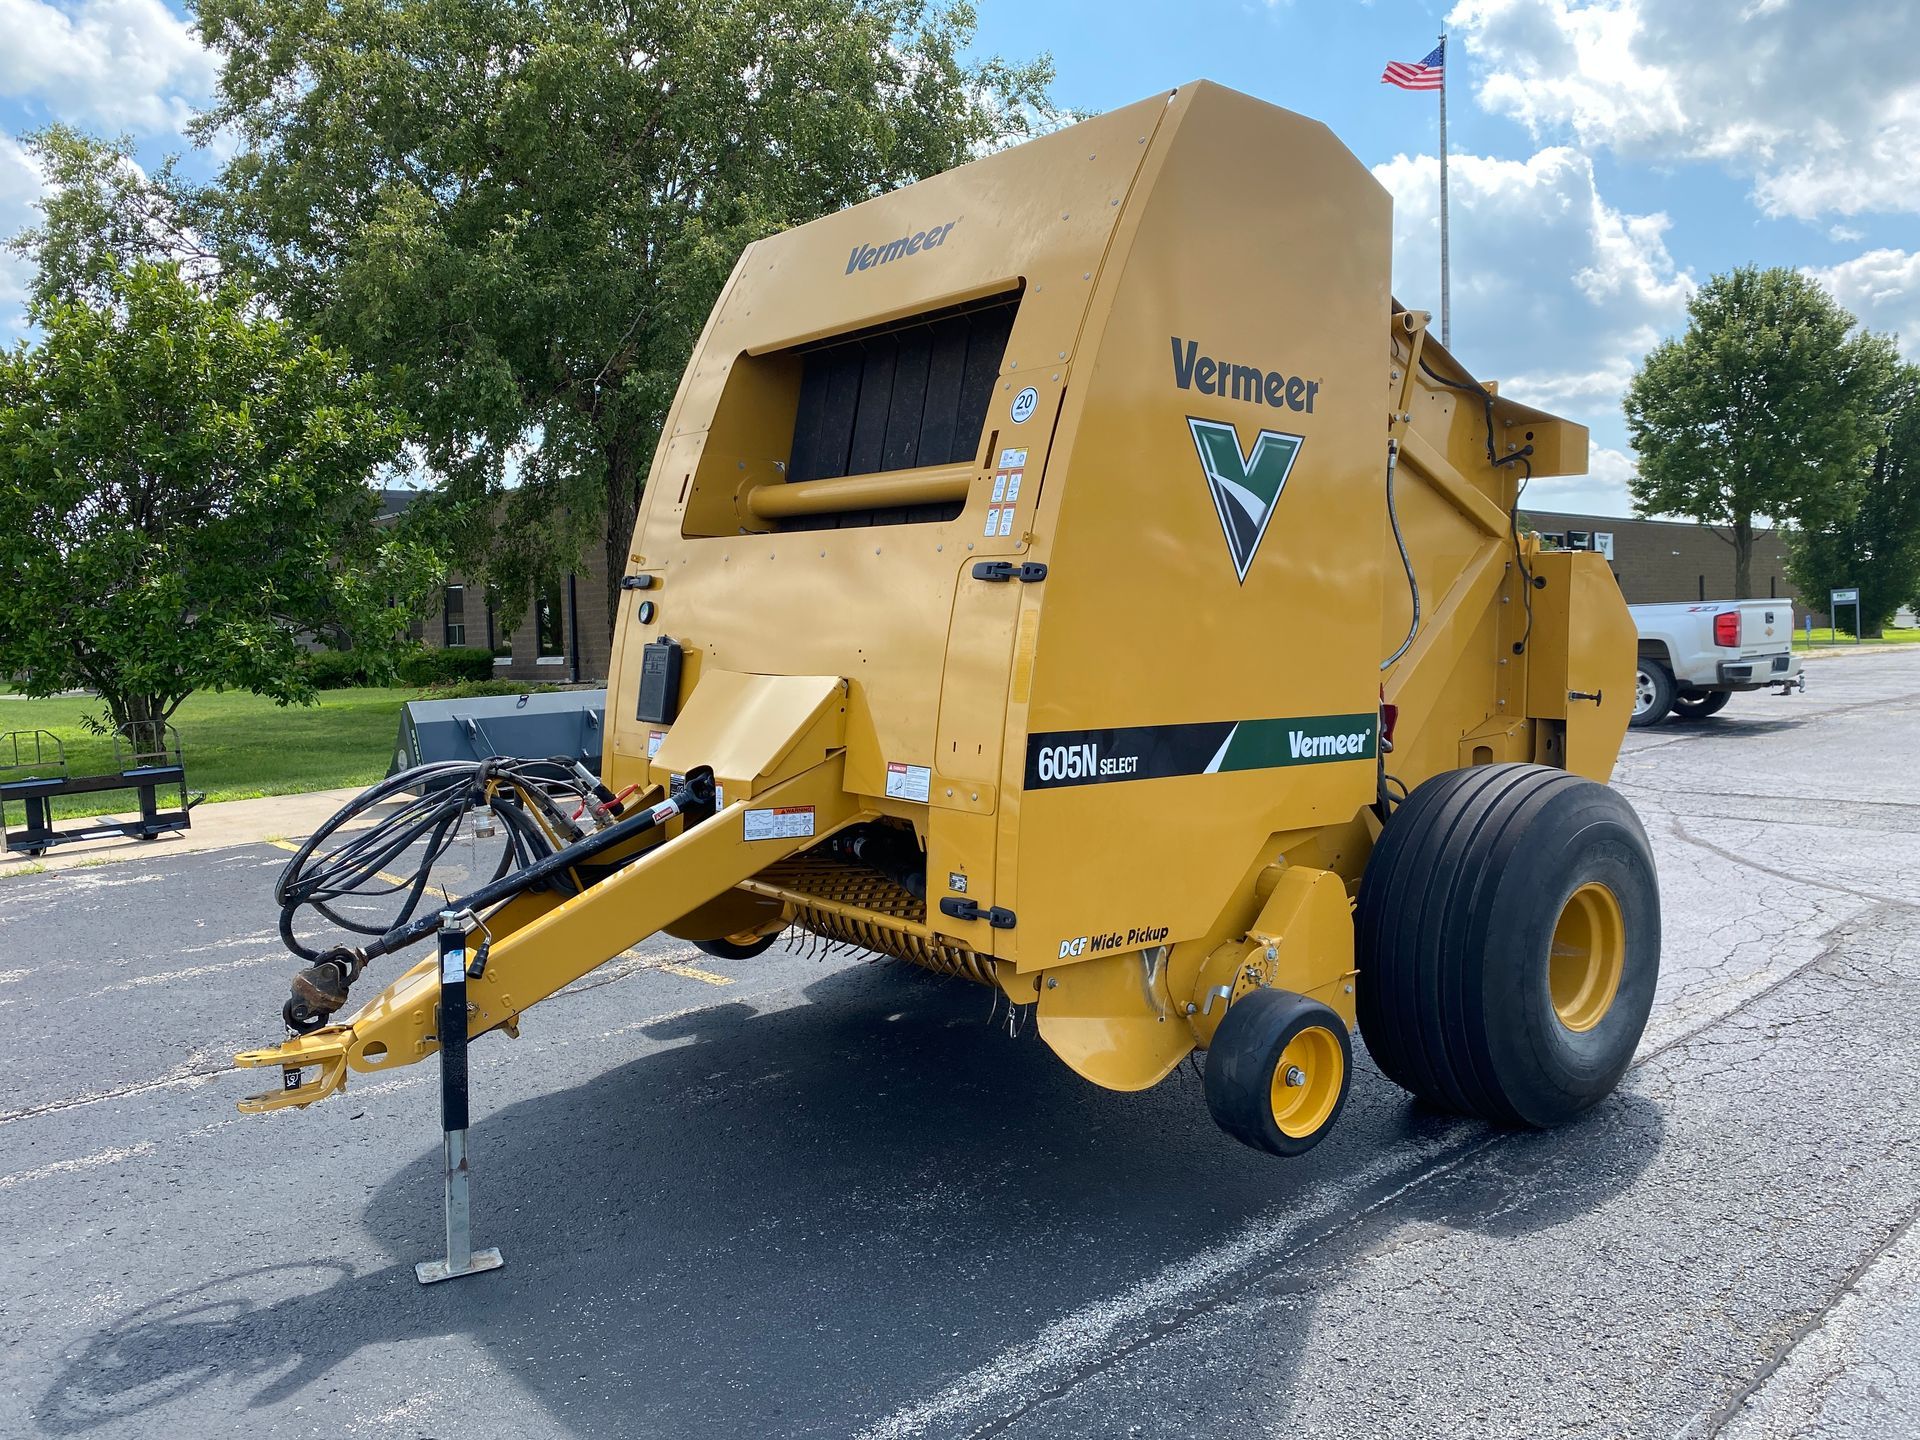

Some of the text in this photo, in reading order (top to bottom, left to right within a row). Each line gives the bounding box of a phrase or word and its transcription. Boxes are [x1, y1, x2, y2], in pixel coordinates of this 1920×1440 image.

[845, 221, 956, 275] Vermeer
[1171, 336, 1319, 414] Vermeer
[1016, 394, 1033, 410] 20
[1288, 730, 1366, 758] Vermeer
[1038, 743, 1138, 781] 605N SELECT
[1058, 926, 1169, 959] DCF Wide Pickup
